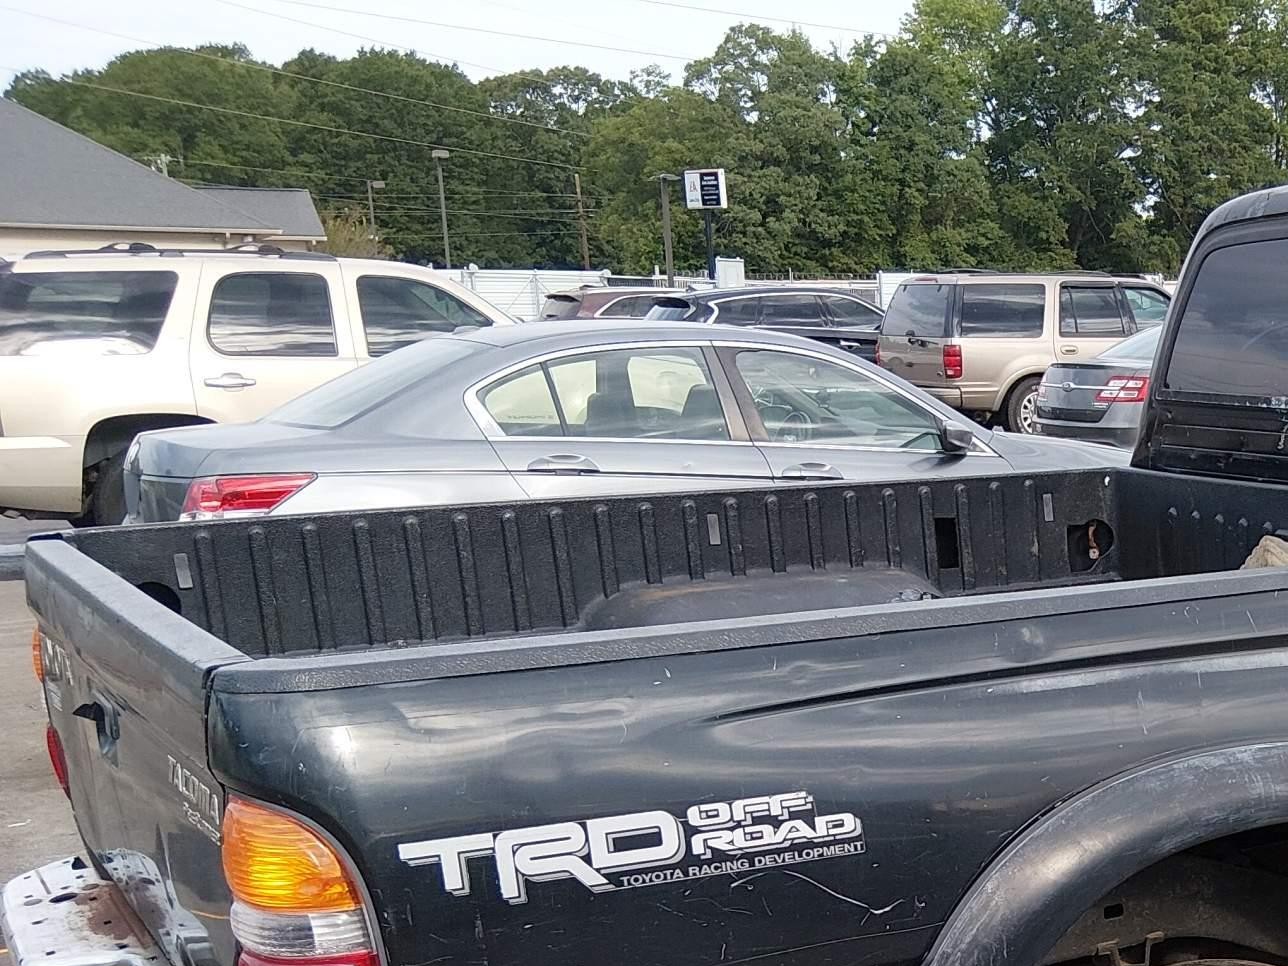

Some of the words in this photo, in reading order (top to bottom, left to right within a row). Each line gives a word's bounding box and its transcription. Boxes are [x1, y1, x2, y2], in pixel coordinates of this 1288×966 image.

[687, 791, 814, 830] OFF
[398, 811, 686, 905] TRD
[690, 812, 863, 859] ROAD
[619, 868, 684, 887] TOYOTA
[688, 857, 750, 876] RACING
[753, 840, 864, 867] DEVELOPMENT
